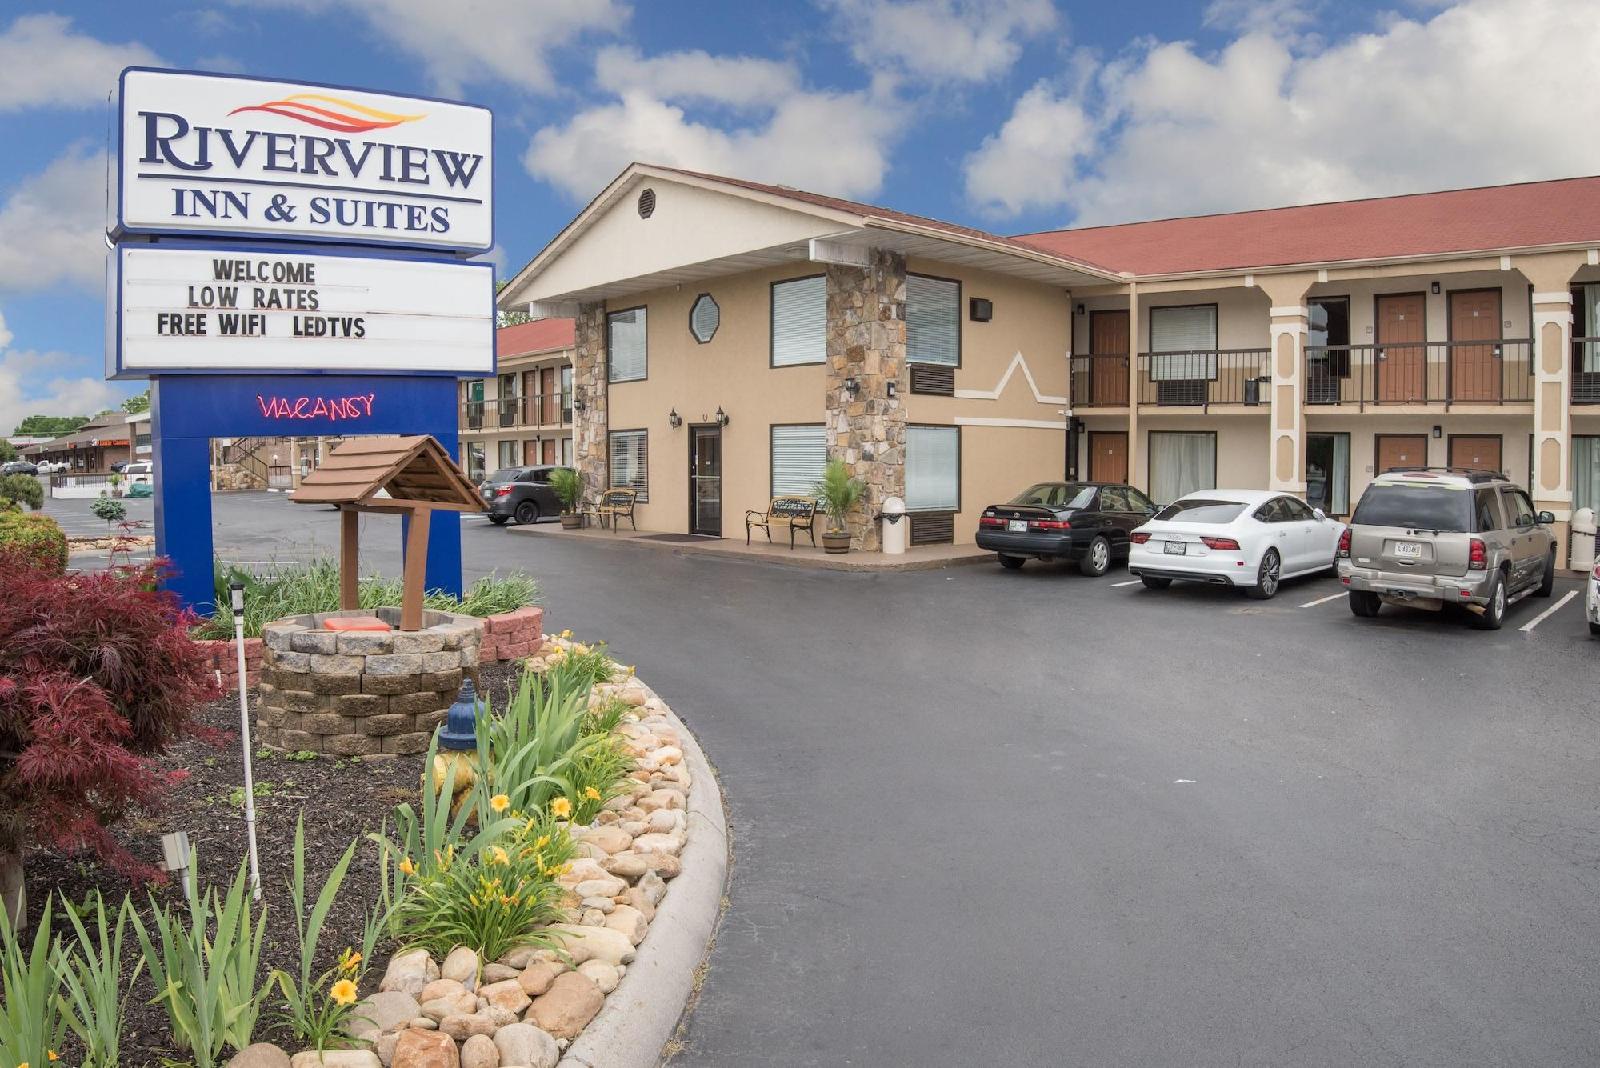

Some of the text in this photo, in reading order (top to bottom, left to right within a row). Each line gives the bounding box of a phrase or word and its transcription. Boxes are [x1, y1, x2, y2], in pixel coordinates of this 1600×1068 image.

[137, 111, 483, 189] RIVERVIEW
[171, 188, 450, 233] INN & SUITES
[213, 259, 315, 283] WELCOME
[188, 286, 319, 310] LOW RATES
[158, 313, 366, 338] FREE WIFI LEDTVS
[257, 393, 375, 421] VACANCY
